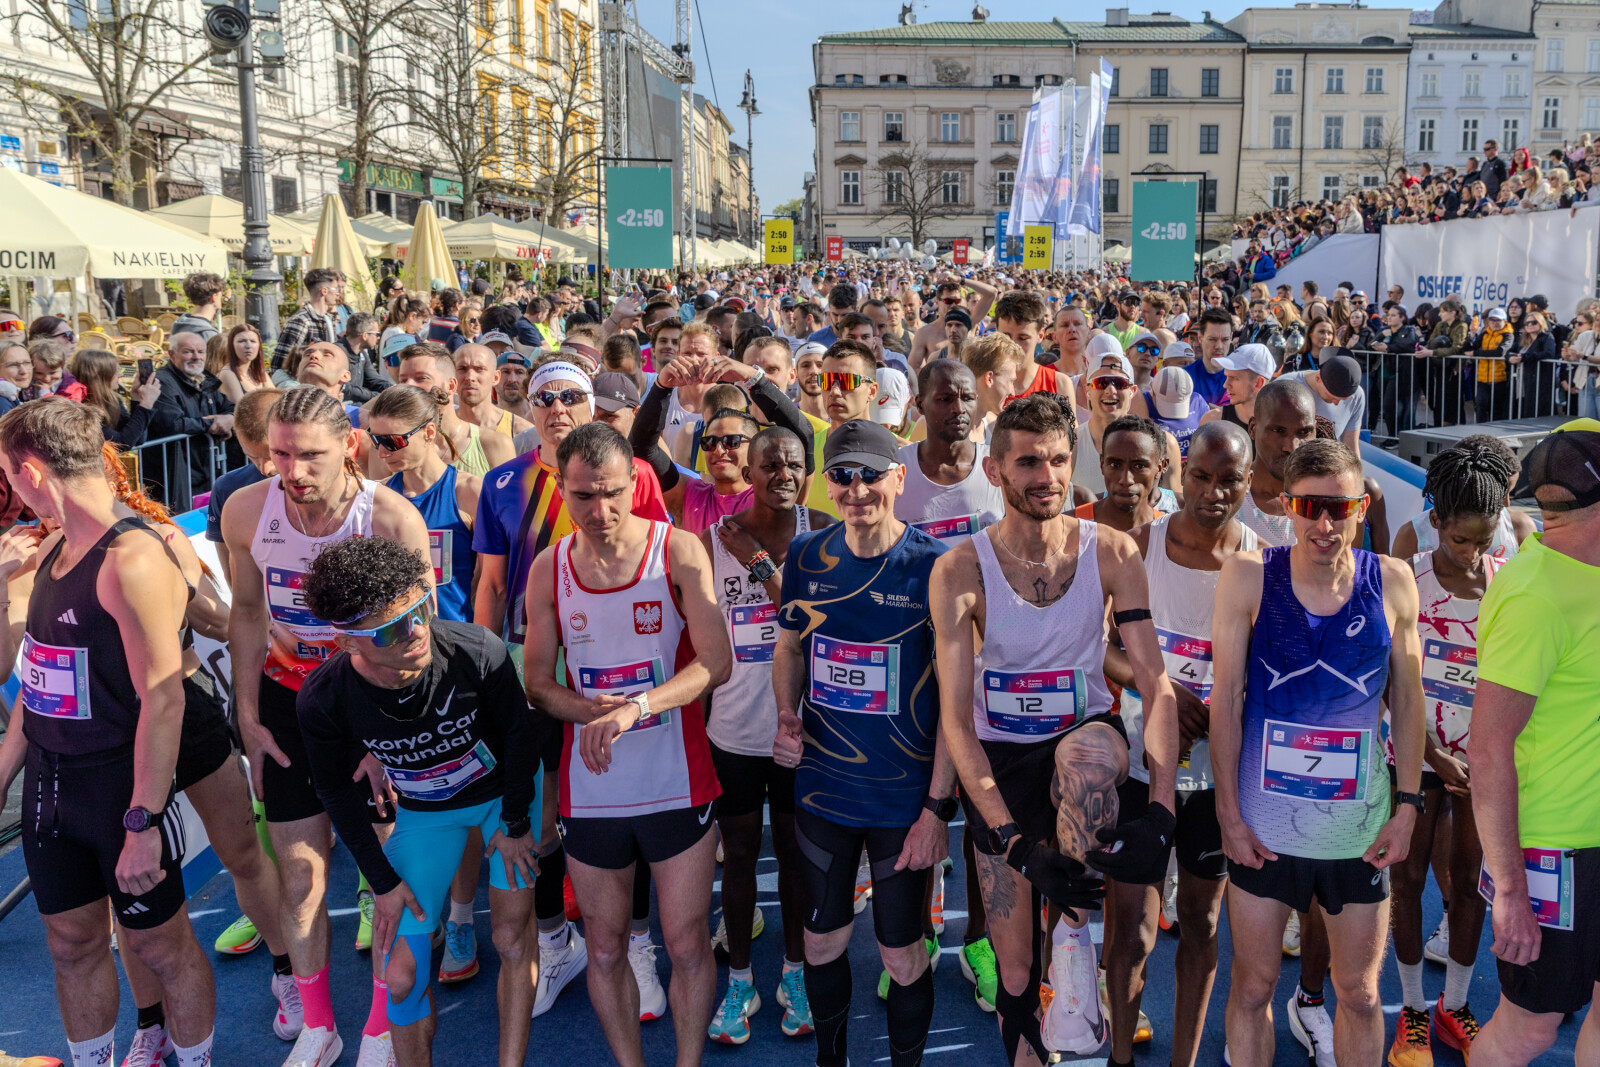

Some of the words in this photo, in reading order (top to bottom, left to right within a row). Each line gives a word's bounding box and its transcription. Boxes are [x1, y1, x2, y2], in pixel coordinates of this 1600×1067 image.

[617, 208, 664, 227] <2:50
[771, 230, 787, 239] 2:50
[1141, 222, 1187, 240] <2:50
[1029, 236, 1046, 244] 2:50
[771, 244, 787, 253] 2:59
[1029, 250, 1045, 258] 2:59
[113, 251, 206, 267] NAKIELNY
[1418, 275, 1462, 298] OSHEE
[1473, 276, 1509, 307] Bieg
[885, 600, 923, 609] MARATHON
[886, 593, 910, 602] SILESIA
[760, 625, 775, 641] 2
[30, 667, 46, 689] 91
[827, 664, 866, 687] 128
[1179, 662, 1198, 679] 4
[1444, 665, 1477, 686] 24
[1016, 697, 1043, 713] 12
[362, 732, 433, 750] Koryo
[437, 708, 478, 735] Car
[372, 729, 473, 765] Hyundai
[1304, 755, 1322, 773] 7
[429, 777, 450, 788] 3
